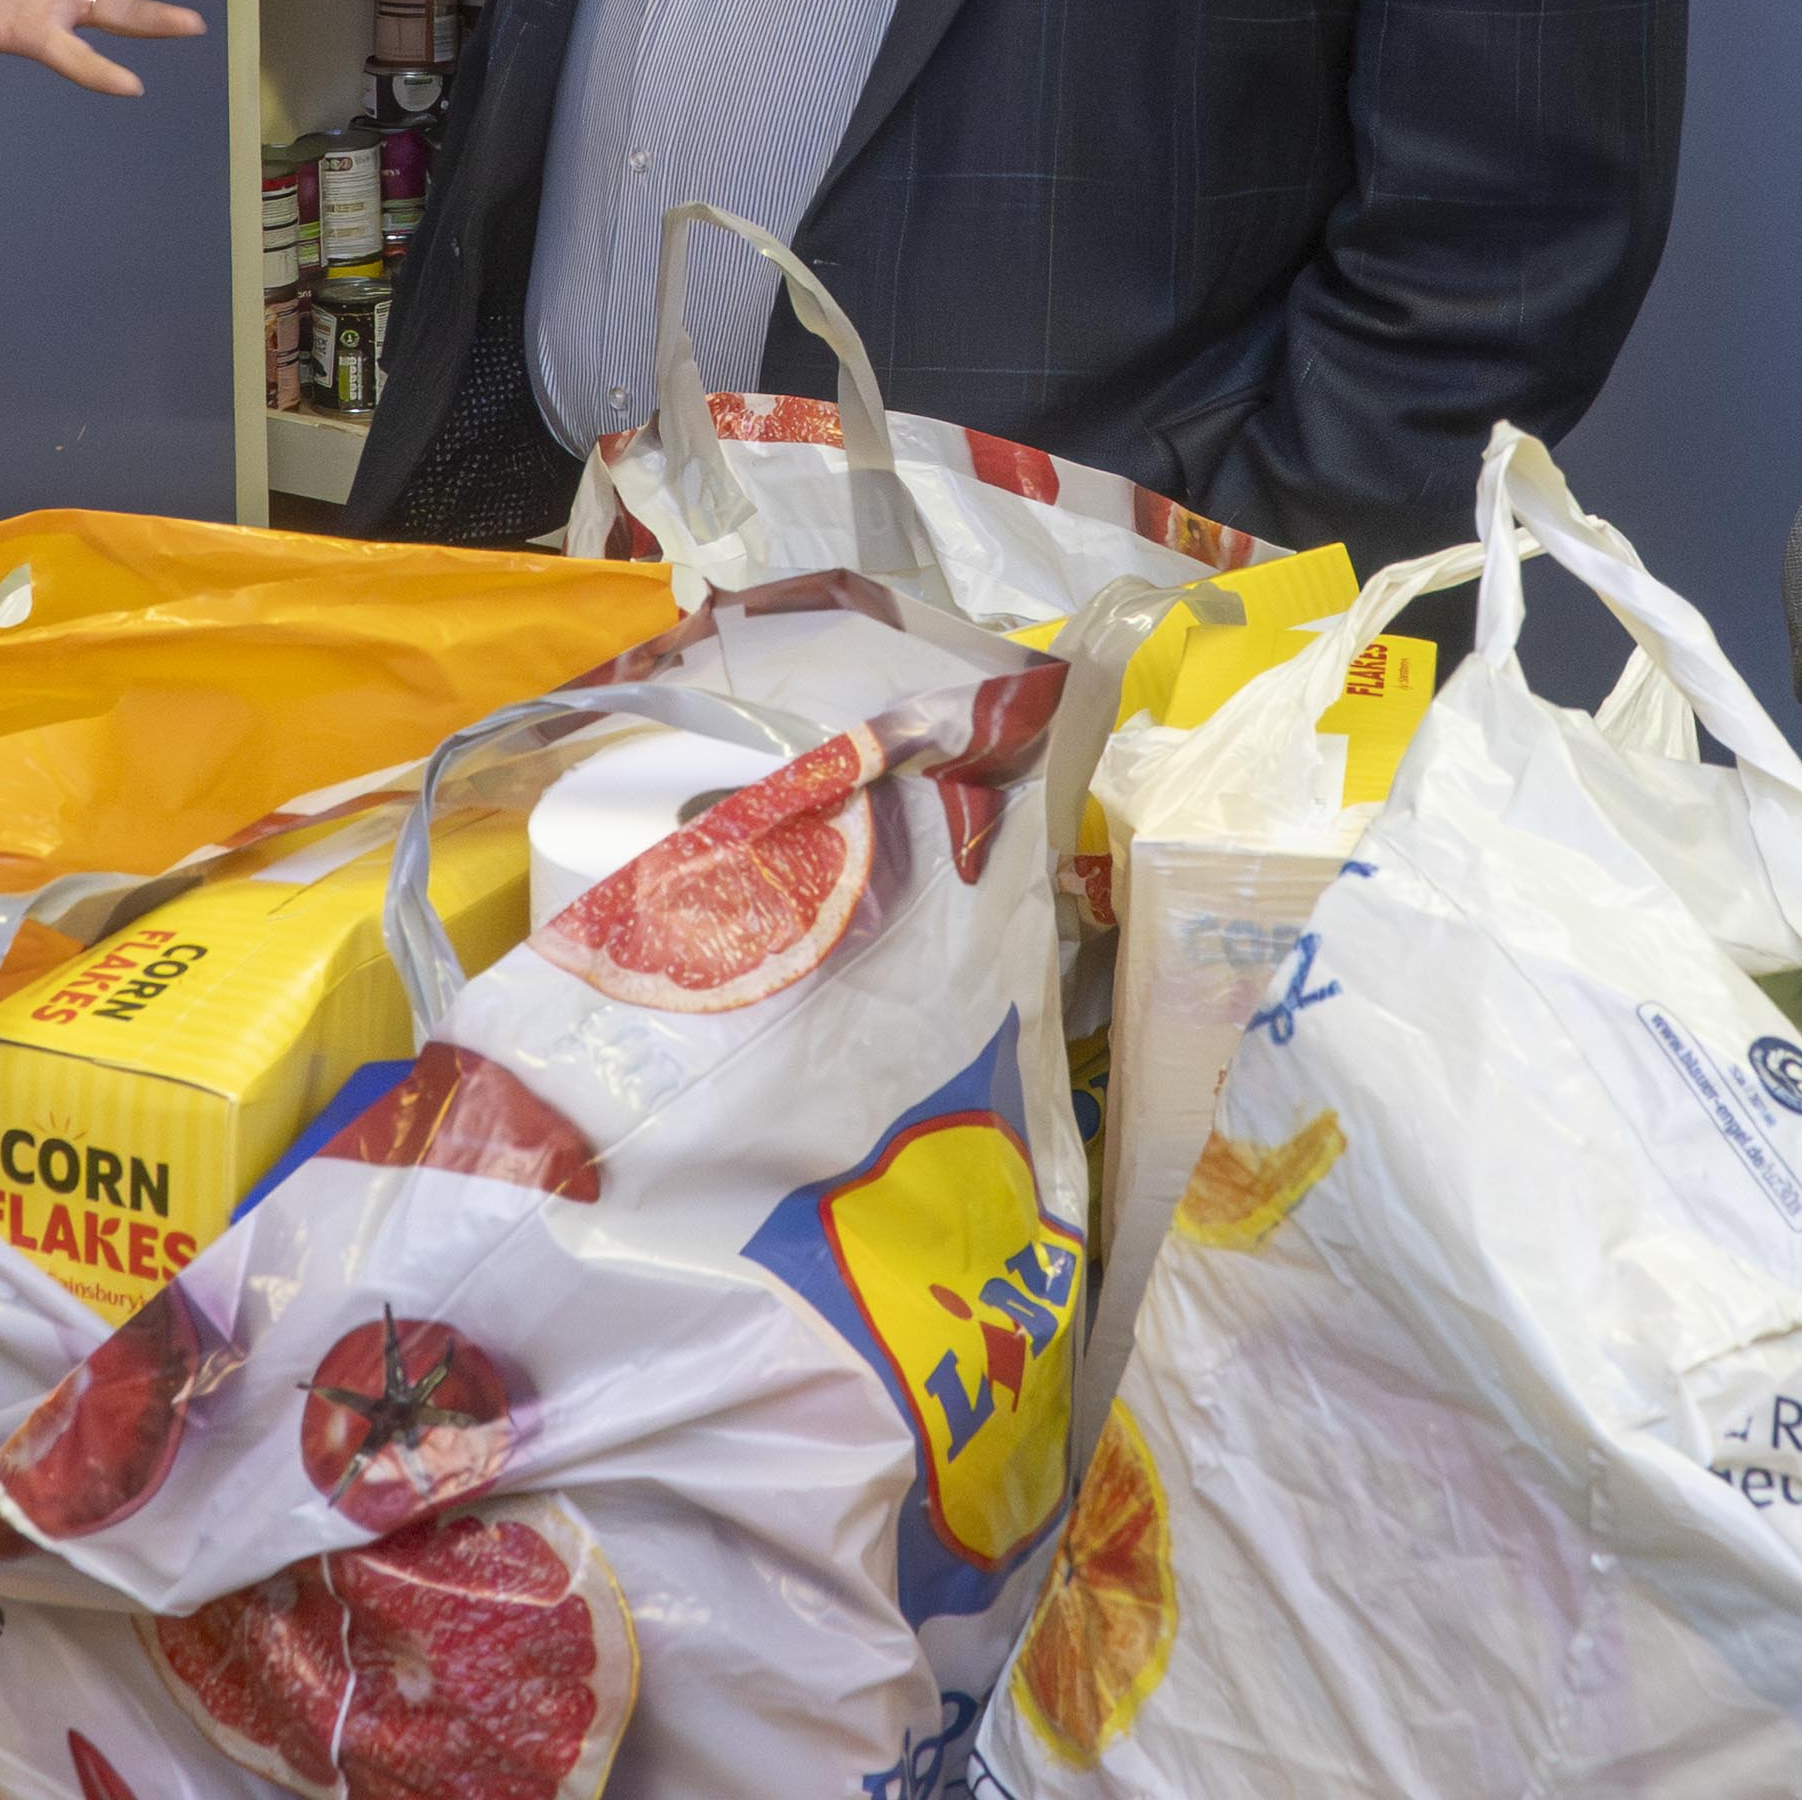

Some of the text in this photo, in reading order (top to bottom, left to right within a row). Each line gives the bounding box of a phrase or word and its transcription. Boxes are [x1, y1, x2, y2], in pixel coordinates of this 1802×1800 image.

[1346, 644, 1389, 698] FLAKES
[30, 930, 177, 1025] FLAKES
[92, 944, 208, 1022] CORN
[0, 1128, 169, 1219] CORN
